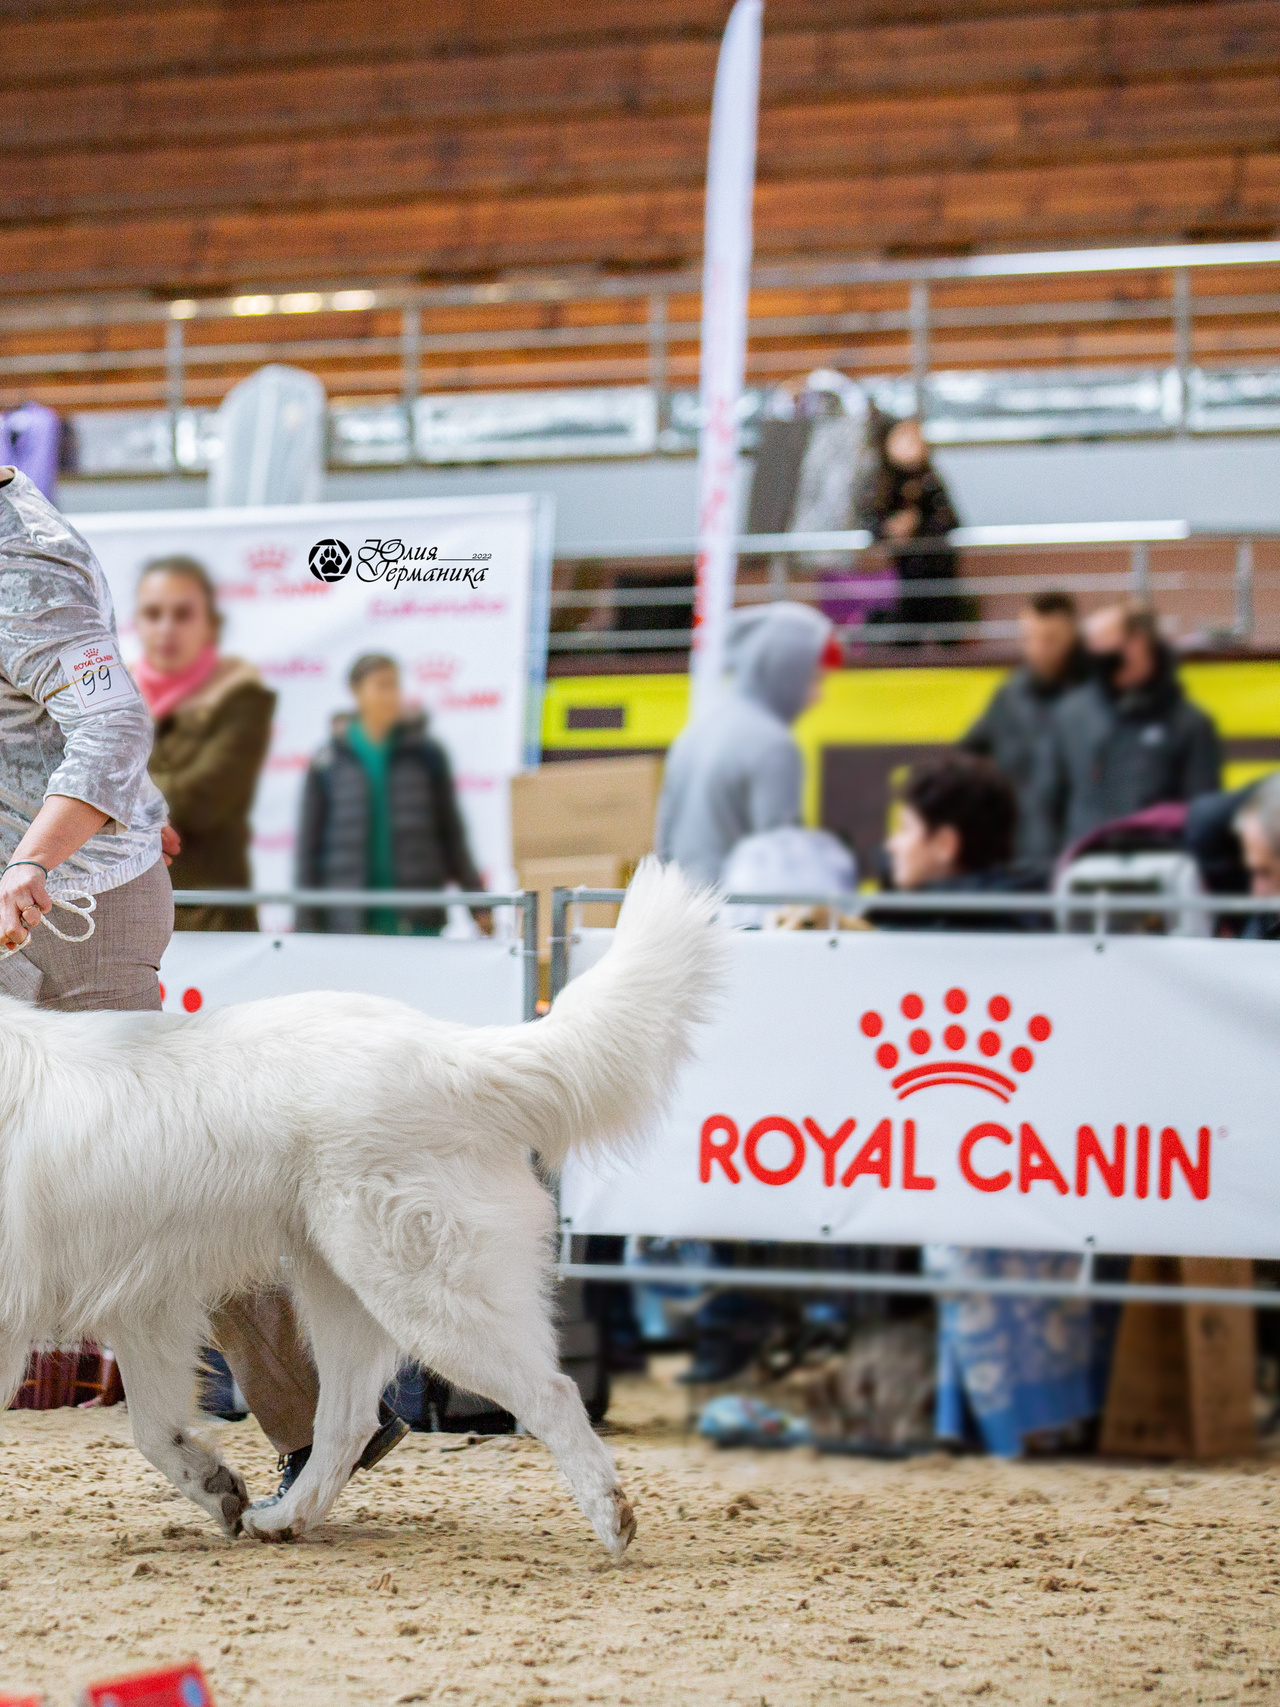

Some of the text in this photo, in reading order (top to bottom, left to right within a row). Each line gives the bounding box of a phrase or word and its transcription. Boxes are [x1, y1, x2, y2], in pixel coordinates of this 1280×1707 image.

[73, 655, 113, 671] ROYAL CANIN
[82, 664, 112, 696] 99
[699, 1114, 1211, 1201] ROYAL CANIN
